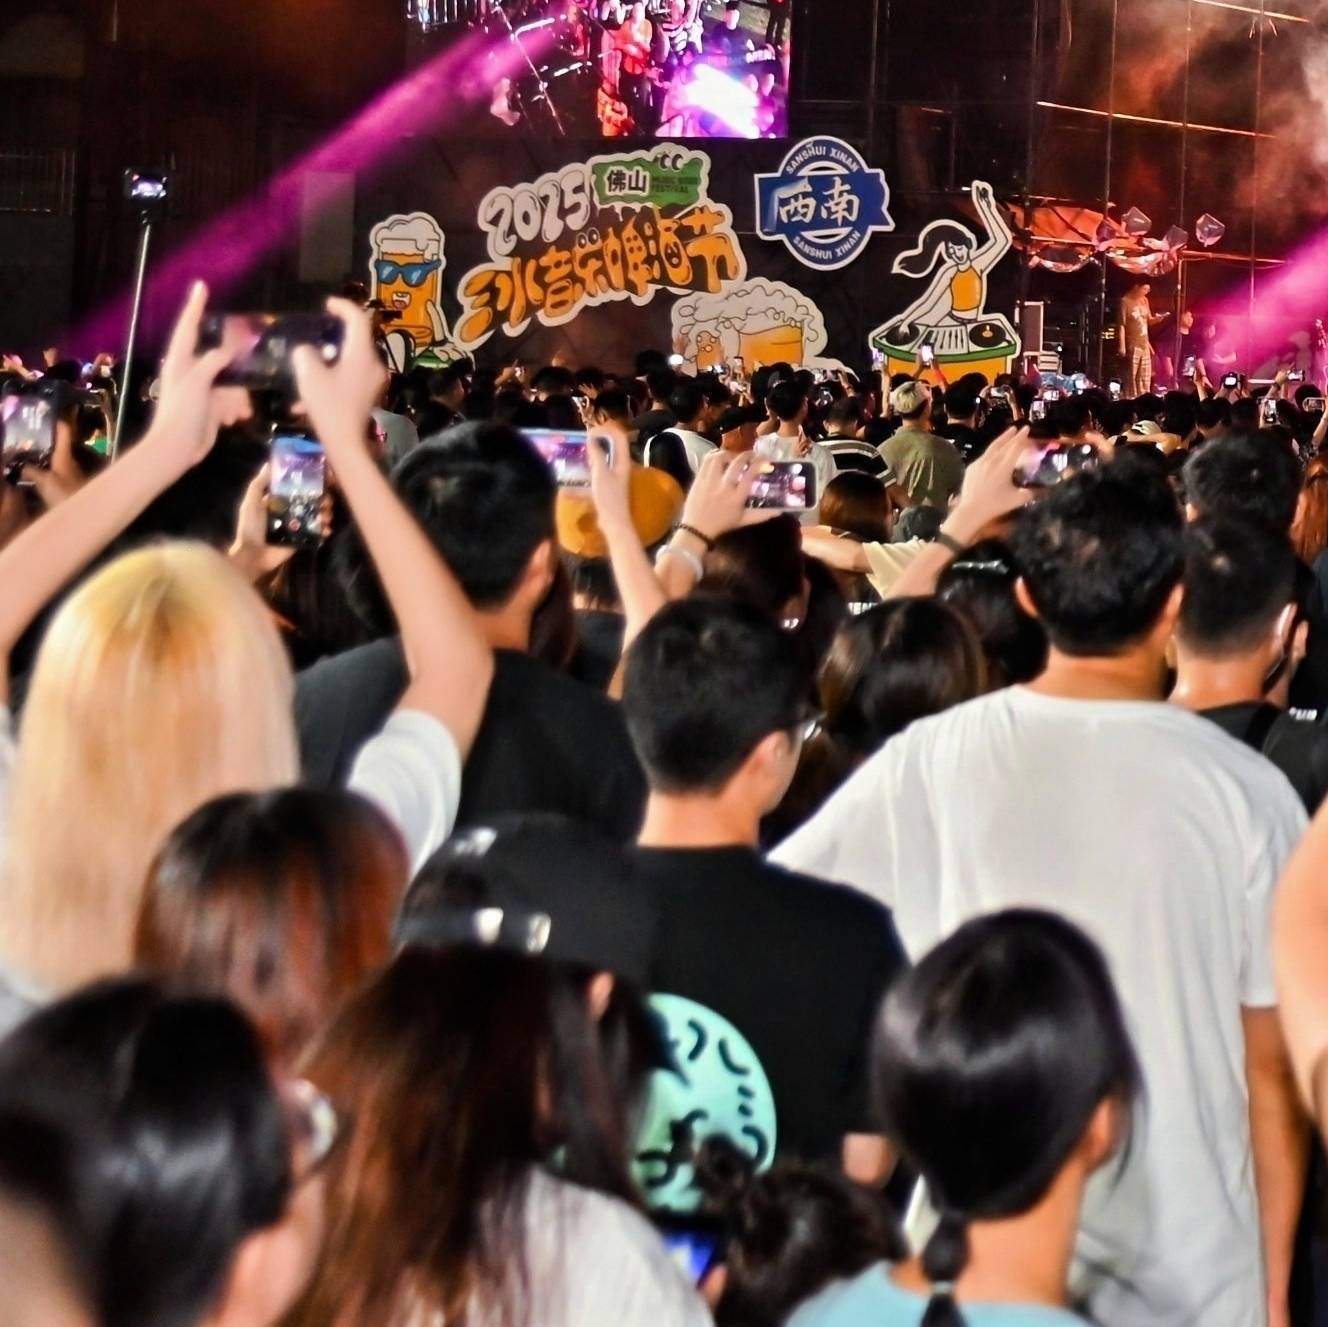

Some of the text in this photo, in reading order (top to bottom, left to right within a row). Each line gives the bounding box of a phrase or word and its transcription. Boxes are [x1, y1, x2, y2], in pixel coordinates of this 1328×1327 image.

[785, 146, 860, 174] SANSHUI XINAN
[607, 169, 647, 193] 佛山
[486, 170, 591, 257] 2025
[776, 176, 860, 226] 西南
[793, 230, 861, 260] SANSHUI XINAN
